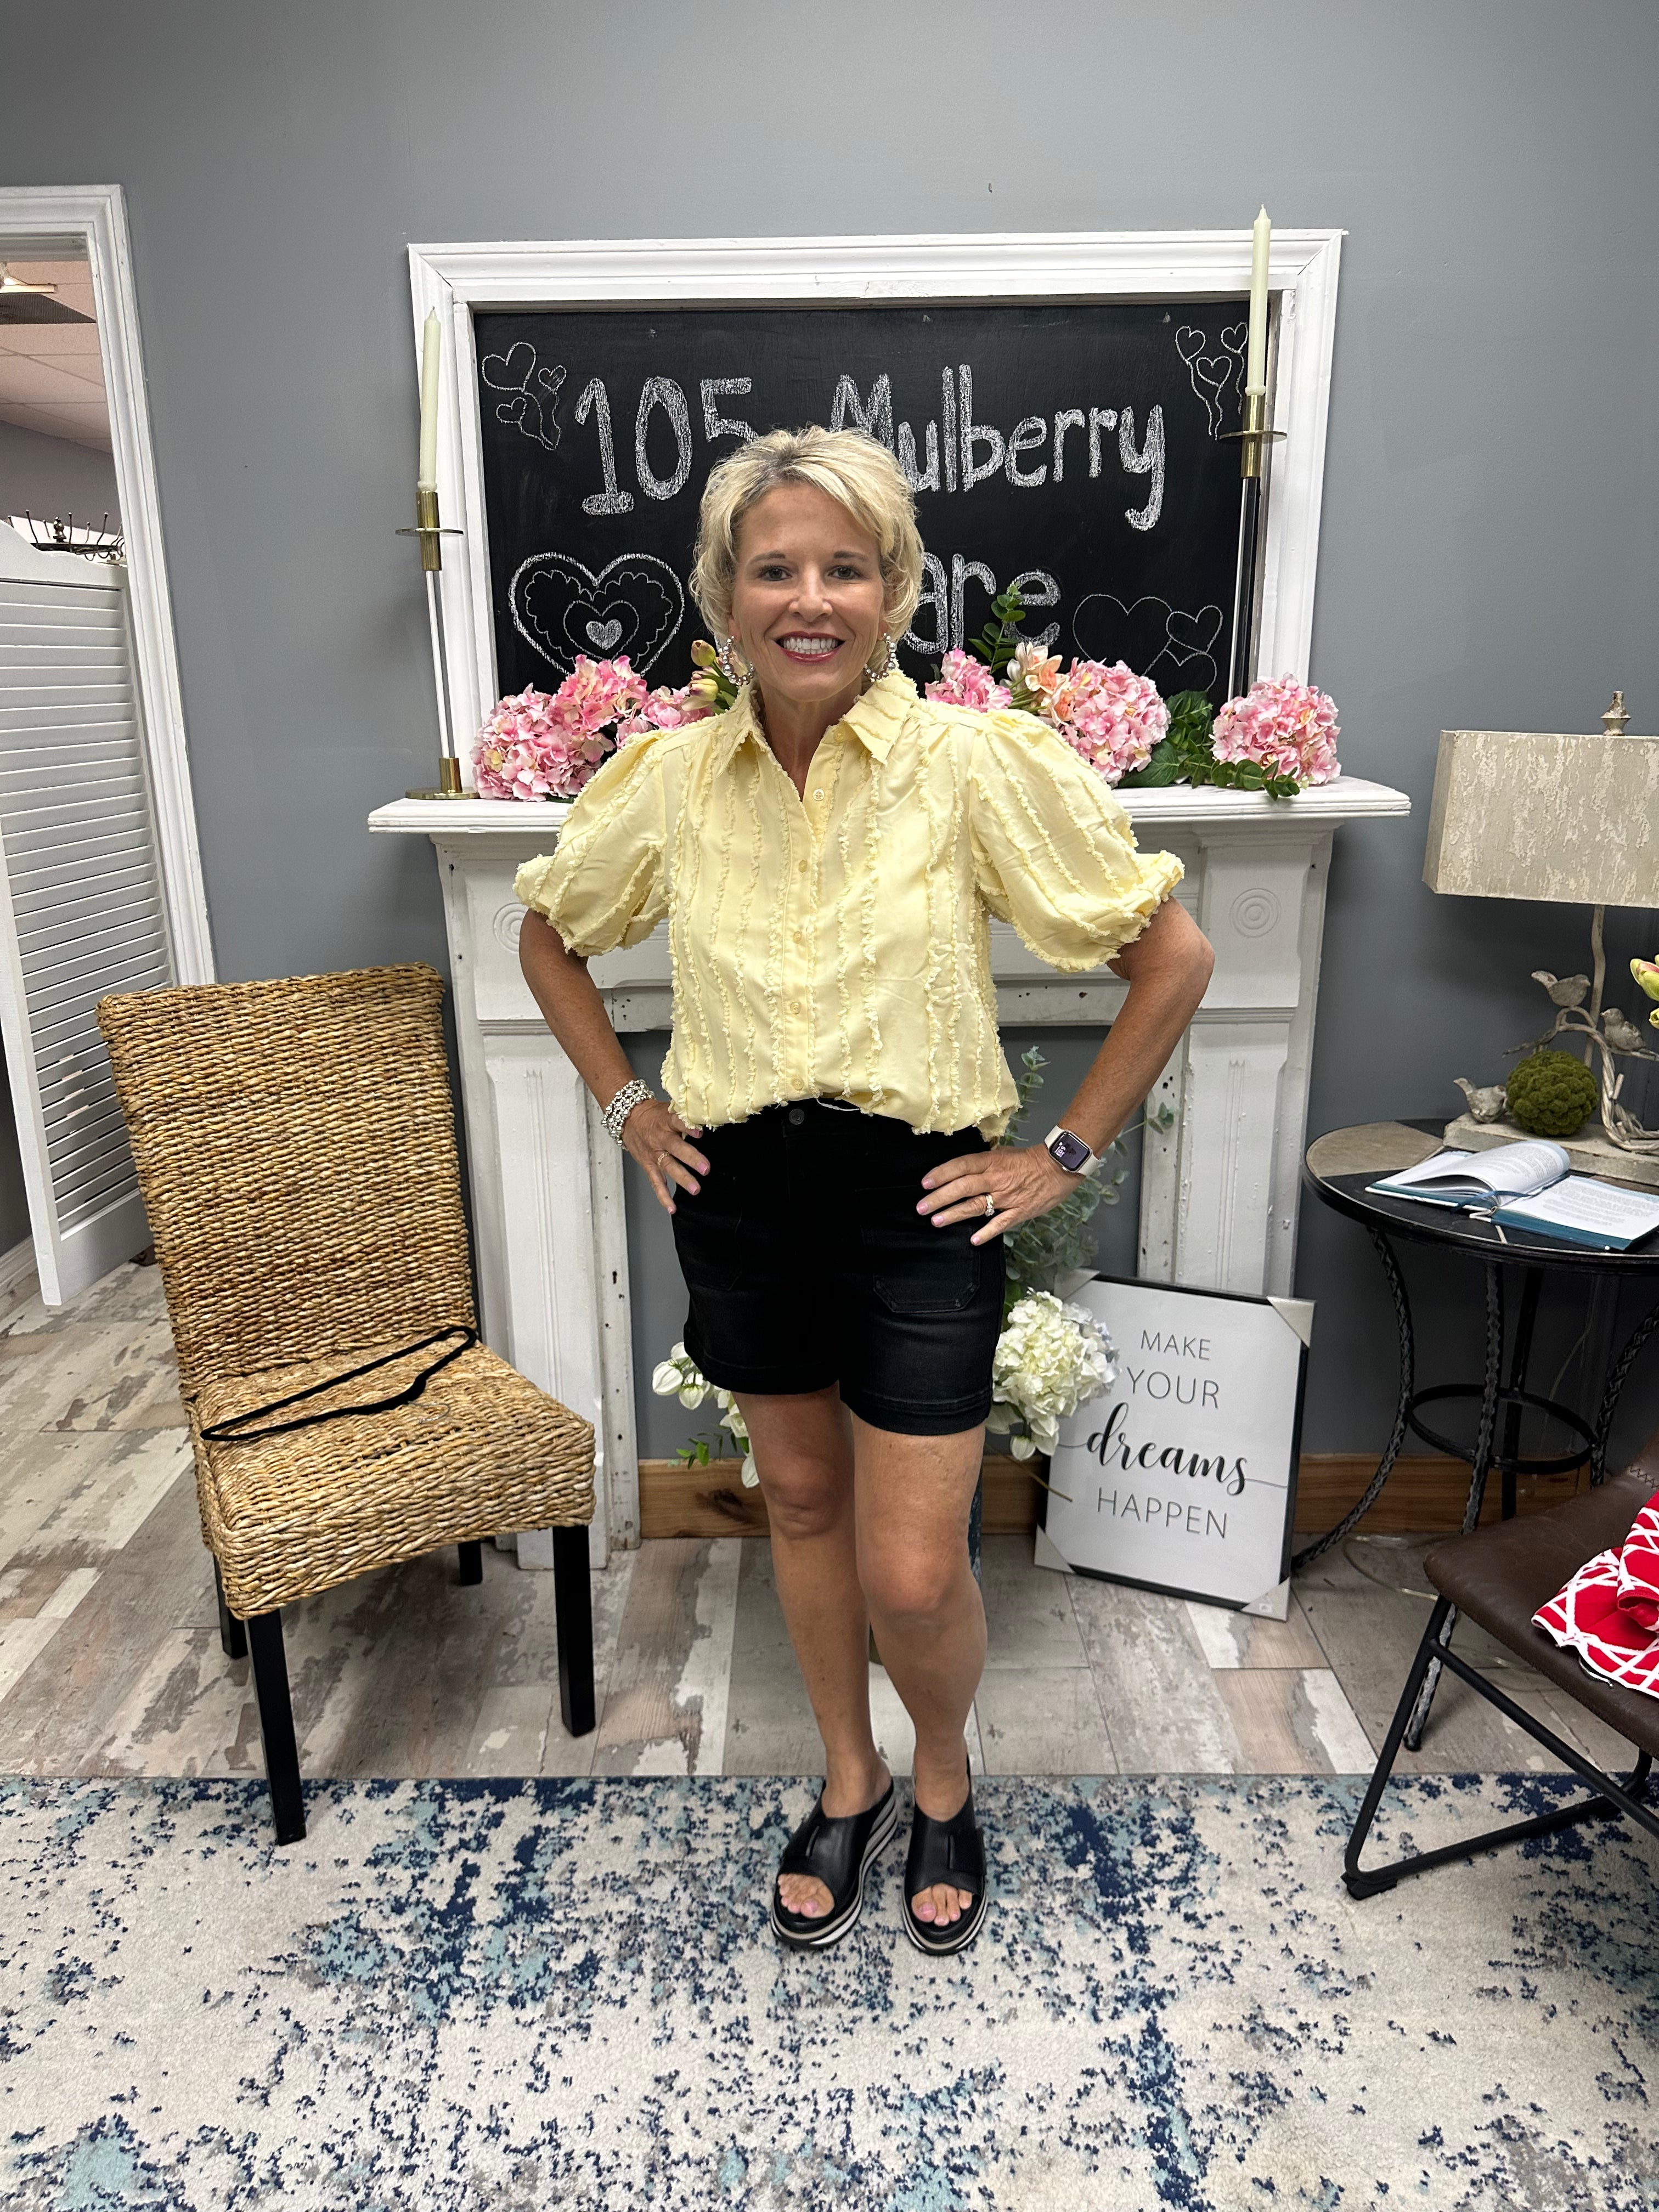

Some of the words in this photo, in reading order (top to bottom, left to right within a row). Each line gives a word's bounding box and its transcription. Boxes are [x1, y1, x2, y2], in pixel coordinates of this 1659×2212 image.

[574, 376, 759, 516] 105
[830, 364, 1165, 531] Mulberry
[905, 551, 1061, 654] are
[1141, 1329, 1211, 1361] MAKE
[1126, 1366, 1220, 1409] YOUR
[1086, 1402, 1248, 1496] dreams
[1097, 1487, 1228, 1539] HAPPEN
